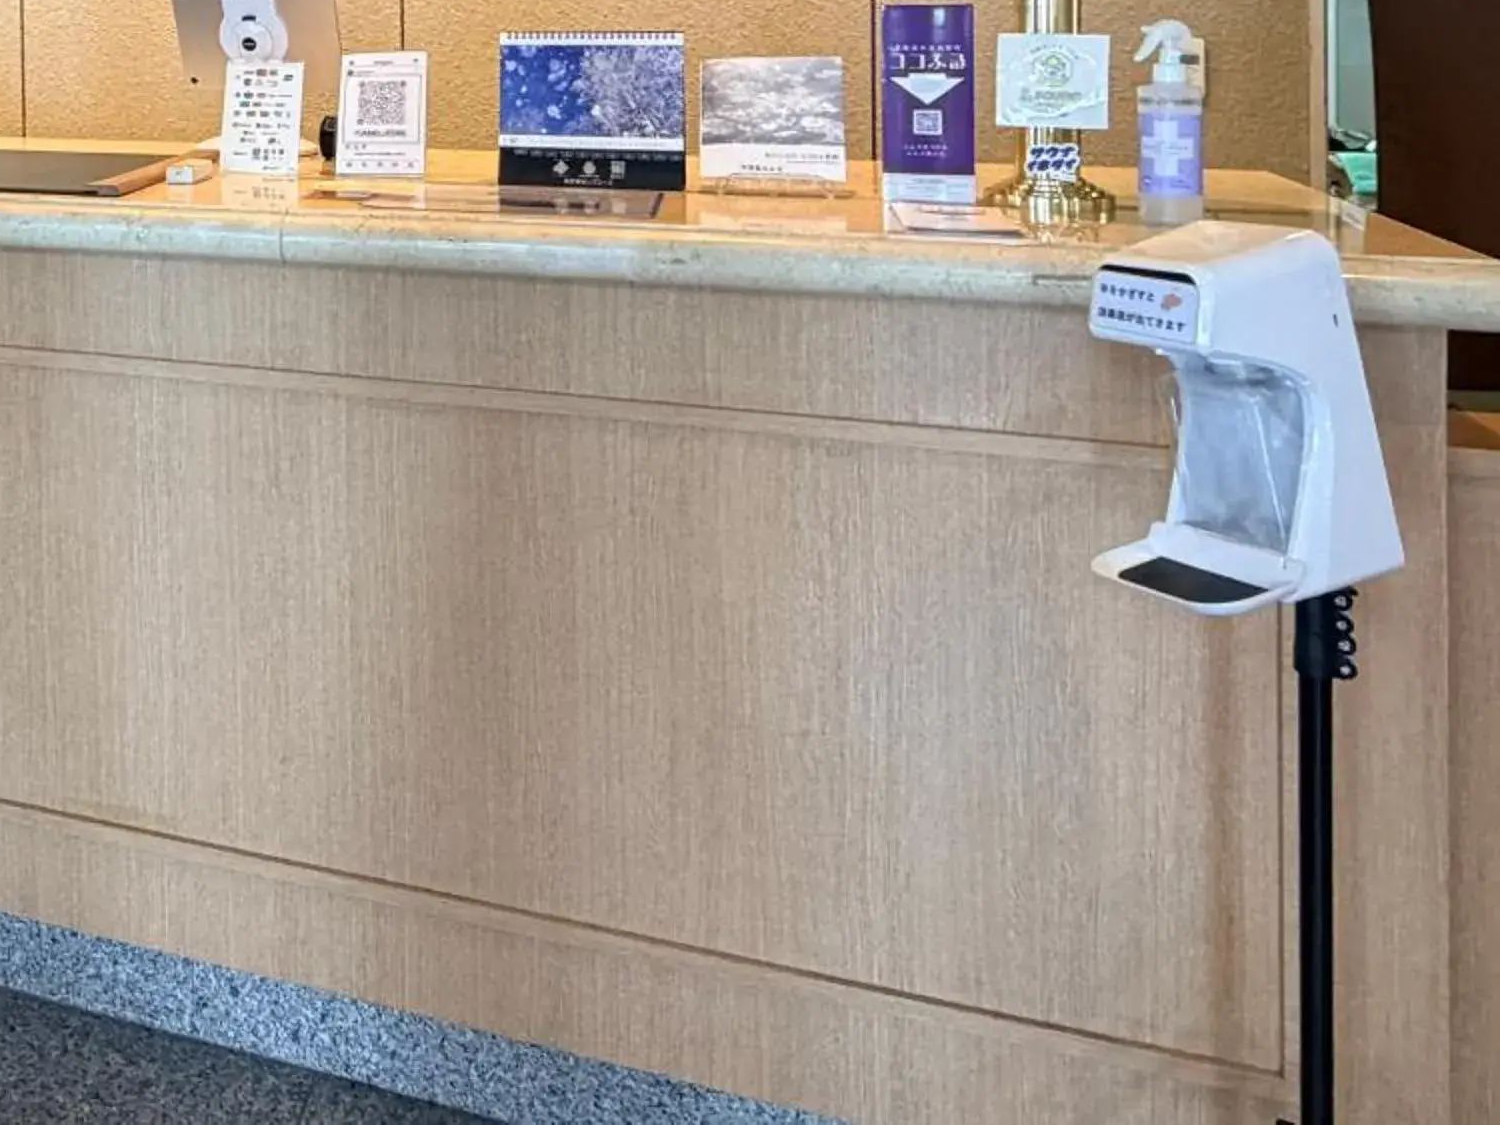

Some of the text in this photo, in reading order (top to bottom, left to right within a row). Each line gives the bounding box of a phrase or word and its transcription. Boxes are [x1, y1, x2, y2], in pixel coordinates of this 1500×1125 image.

[889, 52, 967, 70] ココふる
[1031, 146, 1076, 159] サウナ
